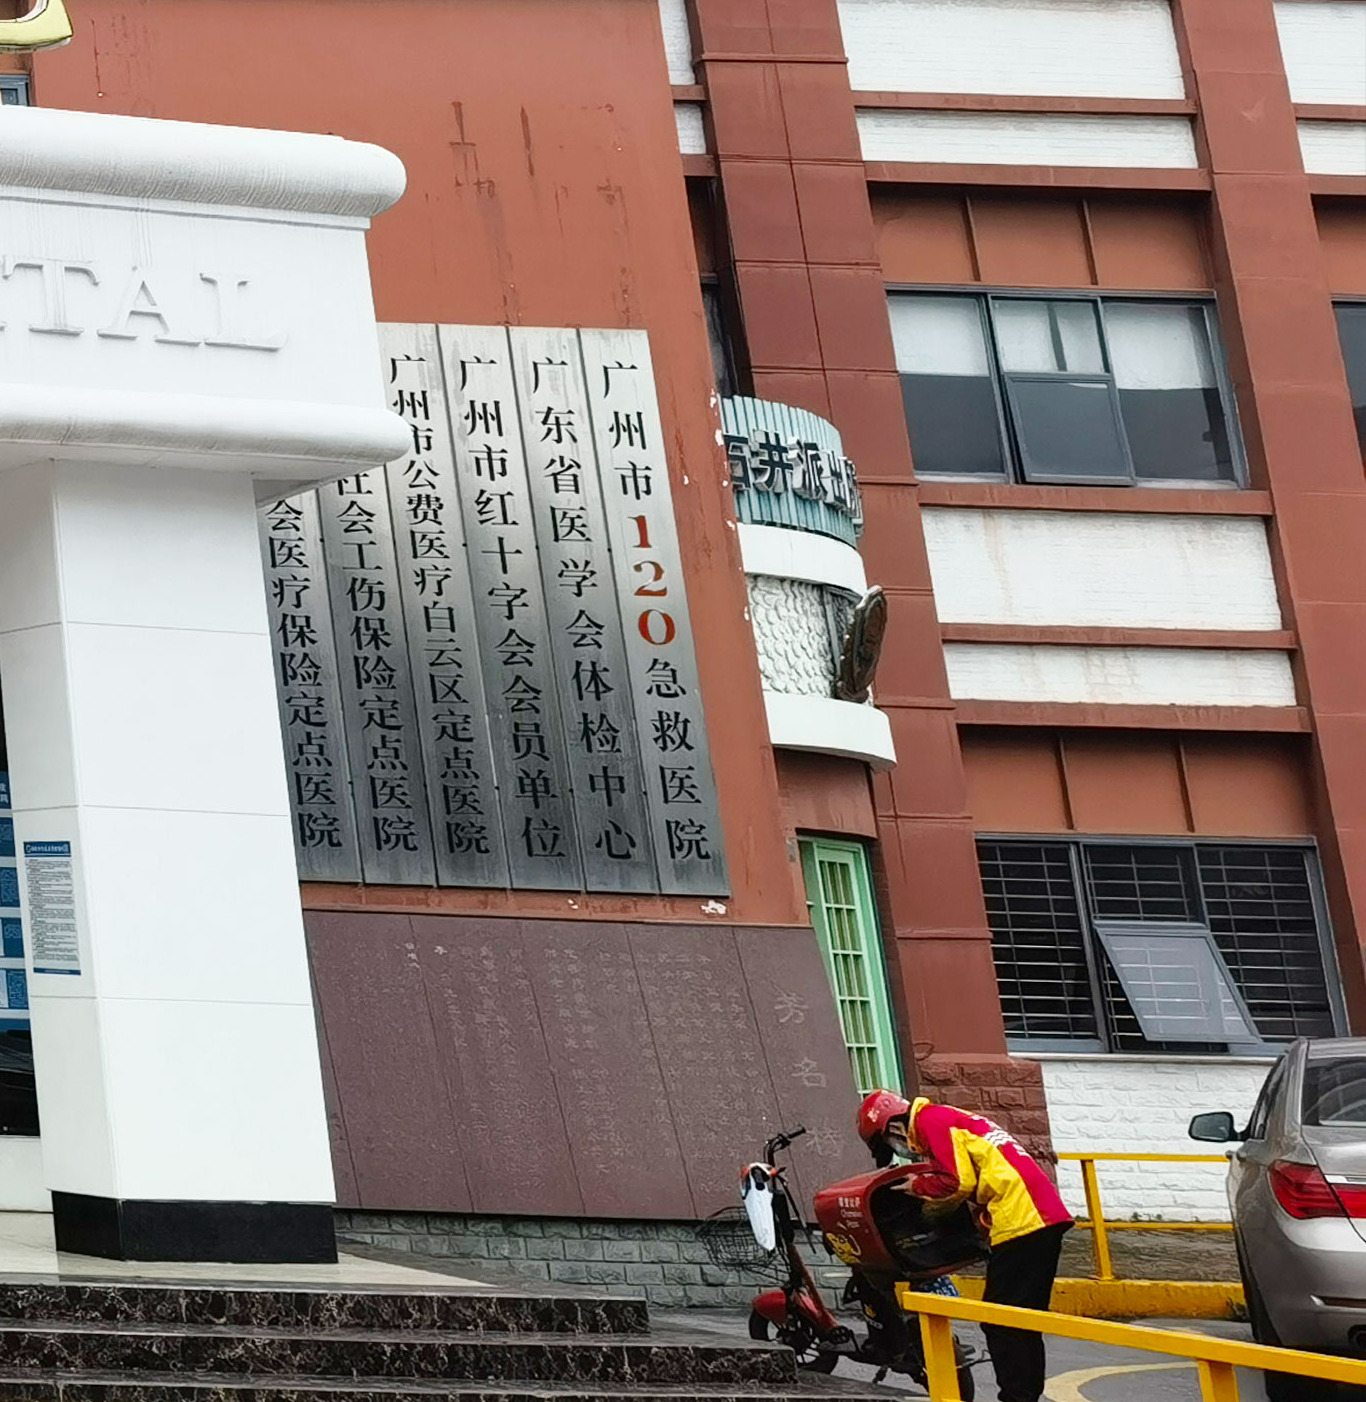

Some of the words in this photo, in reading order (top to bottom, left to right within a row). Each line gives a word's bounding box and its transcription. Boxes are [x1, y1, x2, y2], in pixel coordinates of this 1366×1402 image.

[389, 354, 491, 855] 广州市公费医疗白云区定点医院
[459, 355, 567, 859] 广州市红十字会会员单位
[531, 356, 638, 861] 广东省医学会体检中心
[601, 360, 713, 862] 广州市120急救医院
